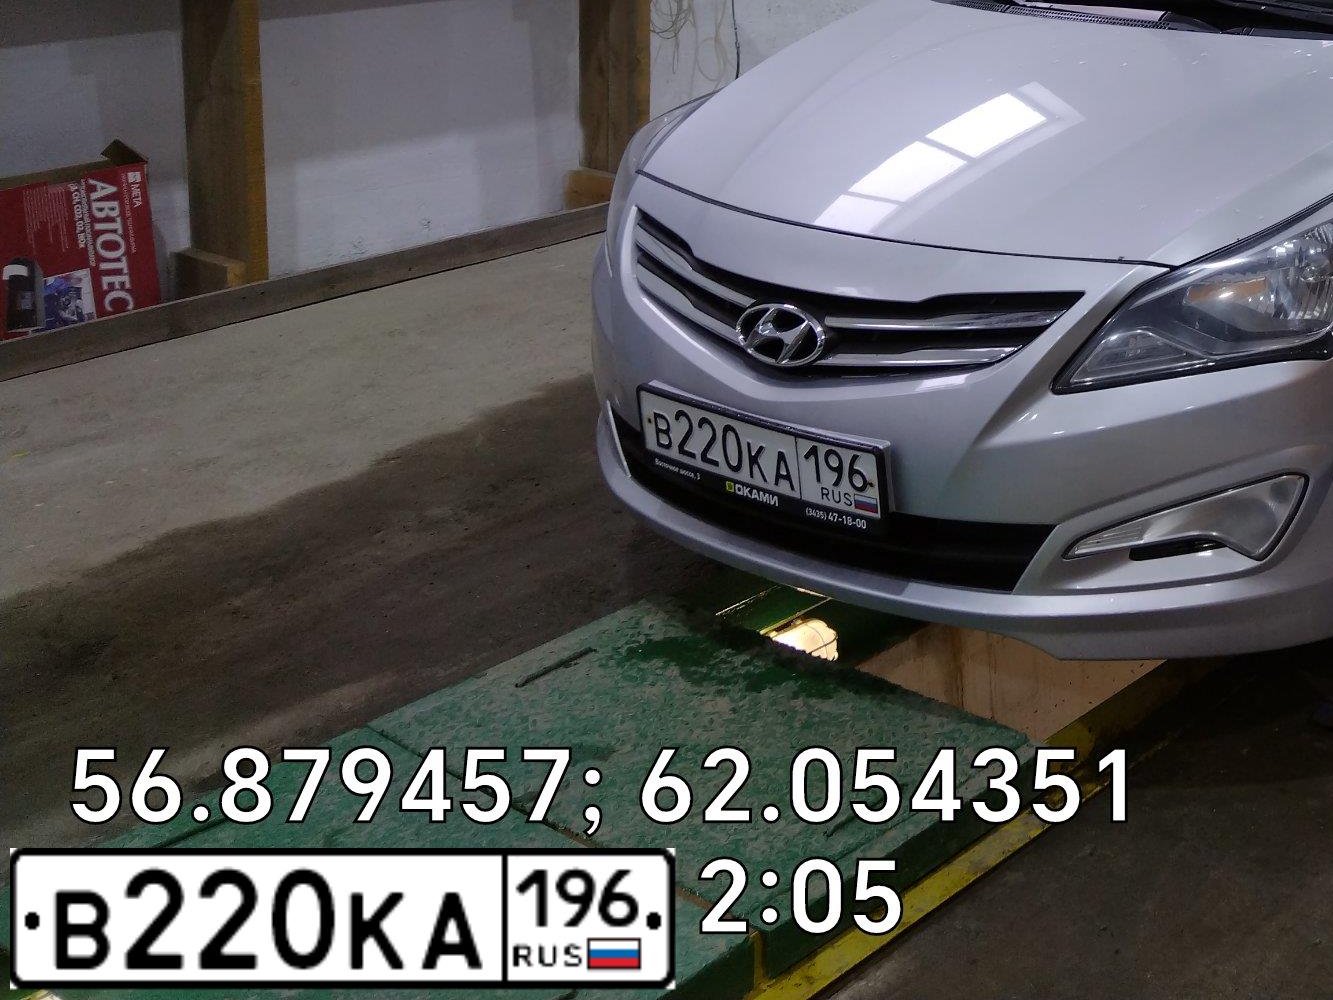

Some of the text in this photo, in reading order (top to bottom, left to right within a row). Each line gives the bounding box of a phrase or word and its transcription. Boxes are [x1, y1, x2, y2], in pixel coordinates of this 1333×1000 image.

[653, 409, 868, 492] В220КА 196
[820, 486, 852, 507] RUS
